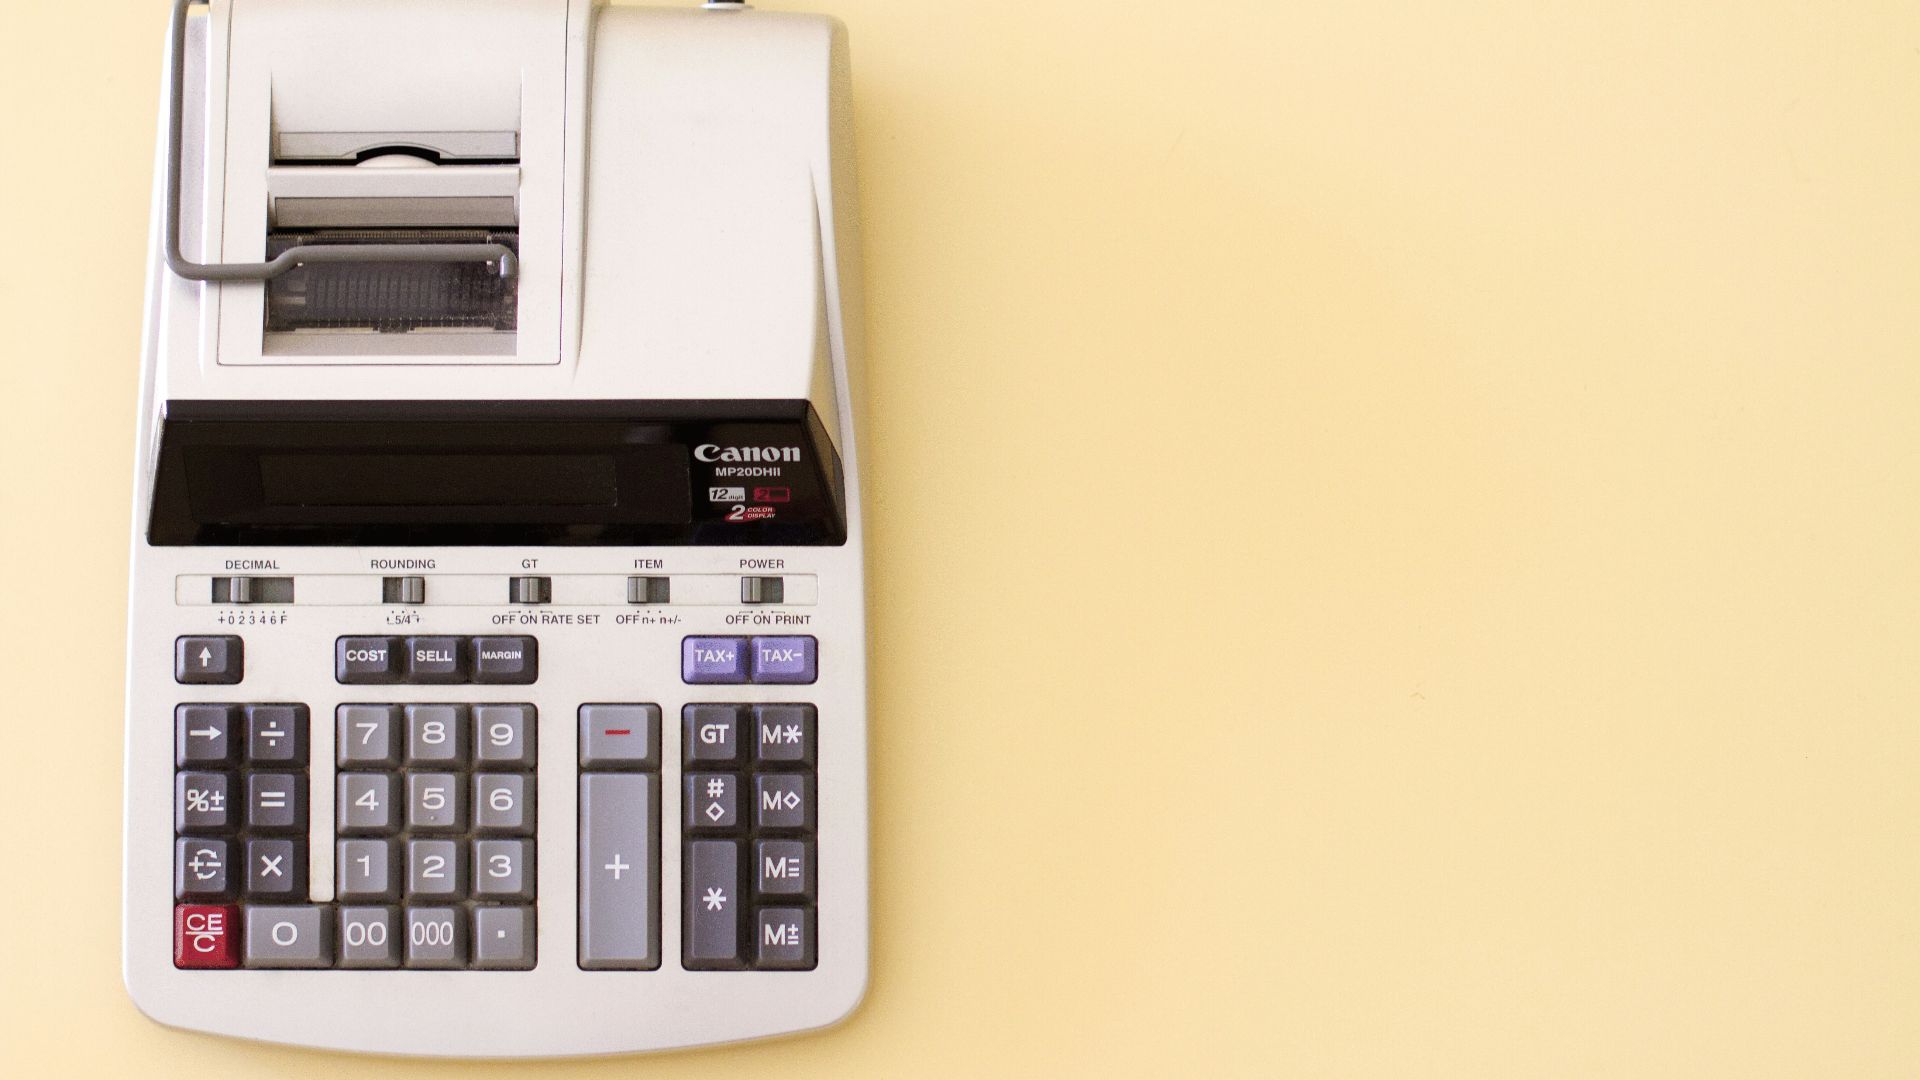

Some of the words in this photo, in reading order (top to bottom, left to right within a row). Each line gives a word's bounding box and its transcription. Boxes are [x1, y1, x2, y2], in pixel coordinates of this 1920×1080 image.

[694, 444, 801, 462] Canon
[715, 467, 780, 477] MP20DHII
[711, 488, 728, 500] 12
[729, 504, 746, 520] 2
[225, 559, 280, 570] DECIMAL
[371, 559, 436, 569] ROUNDING
[522, 559, 538, 569] GT
[634, 559, 663, 569] ITEM
[739, 559, 784, 569] POWER
[492, 615, 516, 625] OFF
[520, 615, 538, 625] ON
[542, 615, 574, 625] RATE
[577, 615, 600, 625] SET
[616, 615, 639, 625] OFF
[725, 615, 750, 625] OFF
[753, 615, 771, 625] ON
[775, 615, 811, 625] PRINT
[346, 649, 387, 662] COST
[416, 650, 452, 662] SELL
[482, 651, 522, 660] MARGIN
[695, 649, 734, 662] TAX+
[355, 722, 379, 745] 7
[422, 721, 446, 745] 8
[490, 723, 514, 746] 9
[701, 725, 729, 743] GT
[355, 789, 379, 810] 4
[422, 787, 446, 810] 5
[489, 788, 514, 811] 6
[357, 855, 370, 876] 1
[423, 856, 445, 878] 2
[488, 855, 512, 877] 3
[186, 913, 223, 931] CE
[271, 921, 298, 946] 0
[346, 921, 387, 946] 00
[412, 921, 454, 946] 000
[192, 934, 215, 953] C
